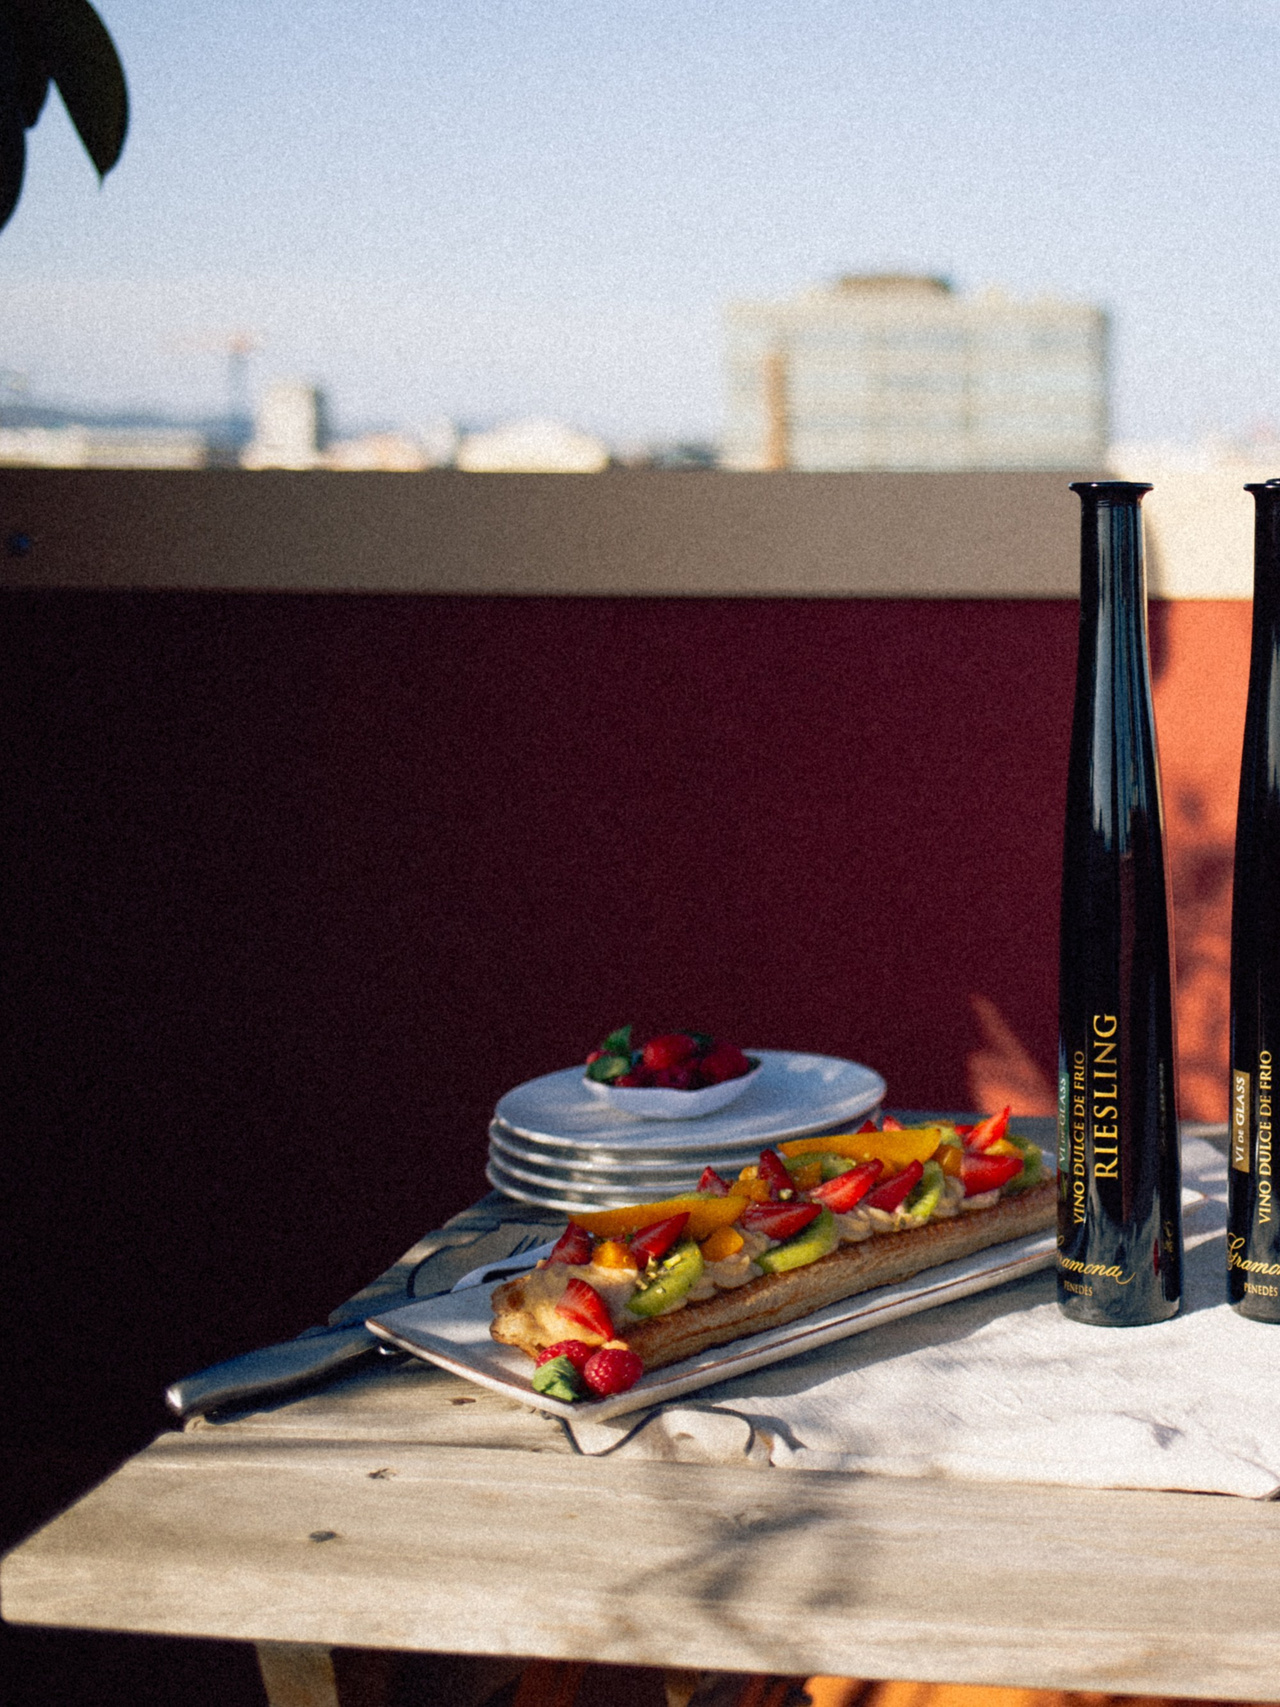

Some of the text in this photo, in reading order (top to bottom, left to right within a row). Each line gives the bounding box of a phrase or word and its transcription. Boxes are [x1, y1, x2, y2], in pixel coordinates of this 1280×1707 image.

[1058, 1077, 1067, 1127] GLASS
[1093, 1013, 1119, 1180] RIESLING
[1235, 1076, 1246, 1127] GLASS
[1058, 1146, 1066, 1163] VI
[1073, 1050, 1086, 1225] VINO DULCE DE FRIO
[1235, 1146, 1245, 1163] VI
[1258, 1050, 1273, 1225] VINO DULCE DE FRIO
[1243, 1282, 1279, 1297] PENEDÈS
